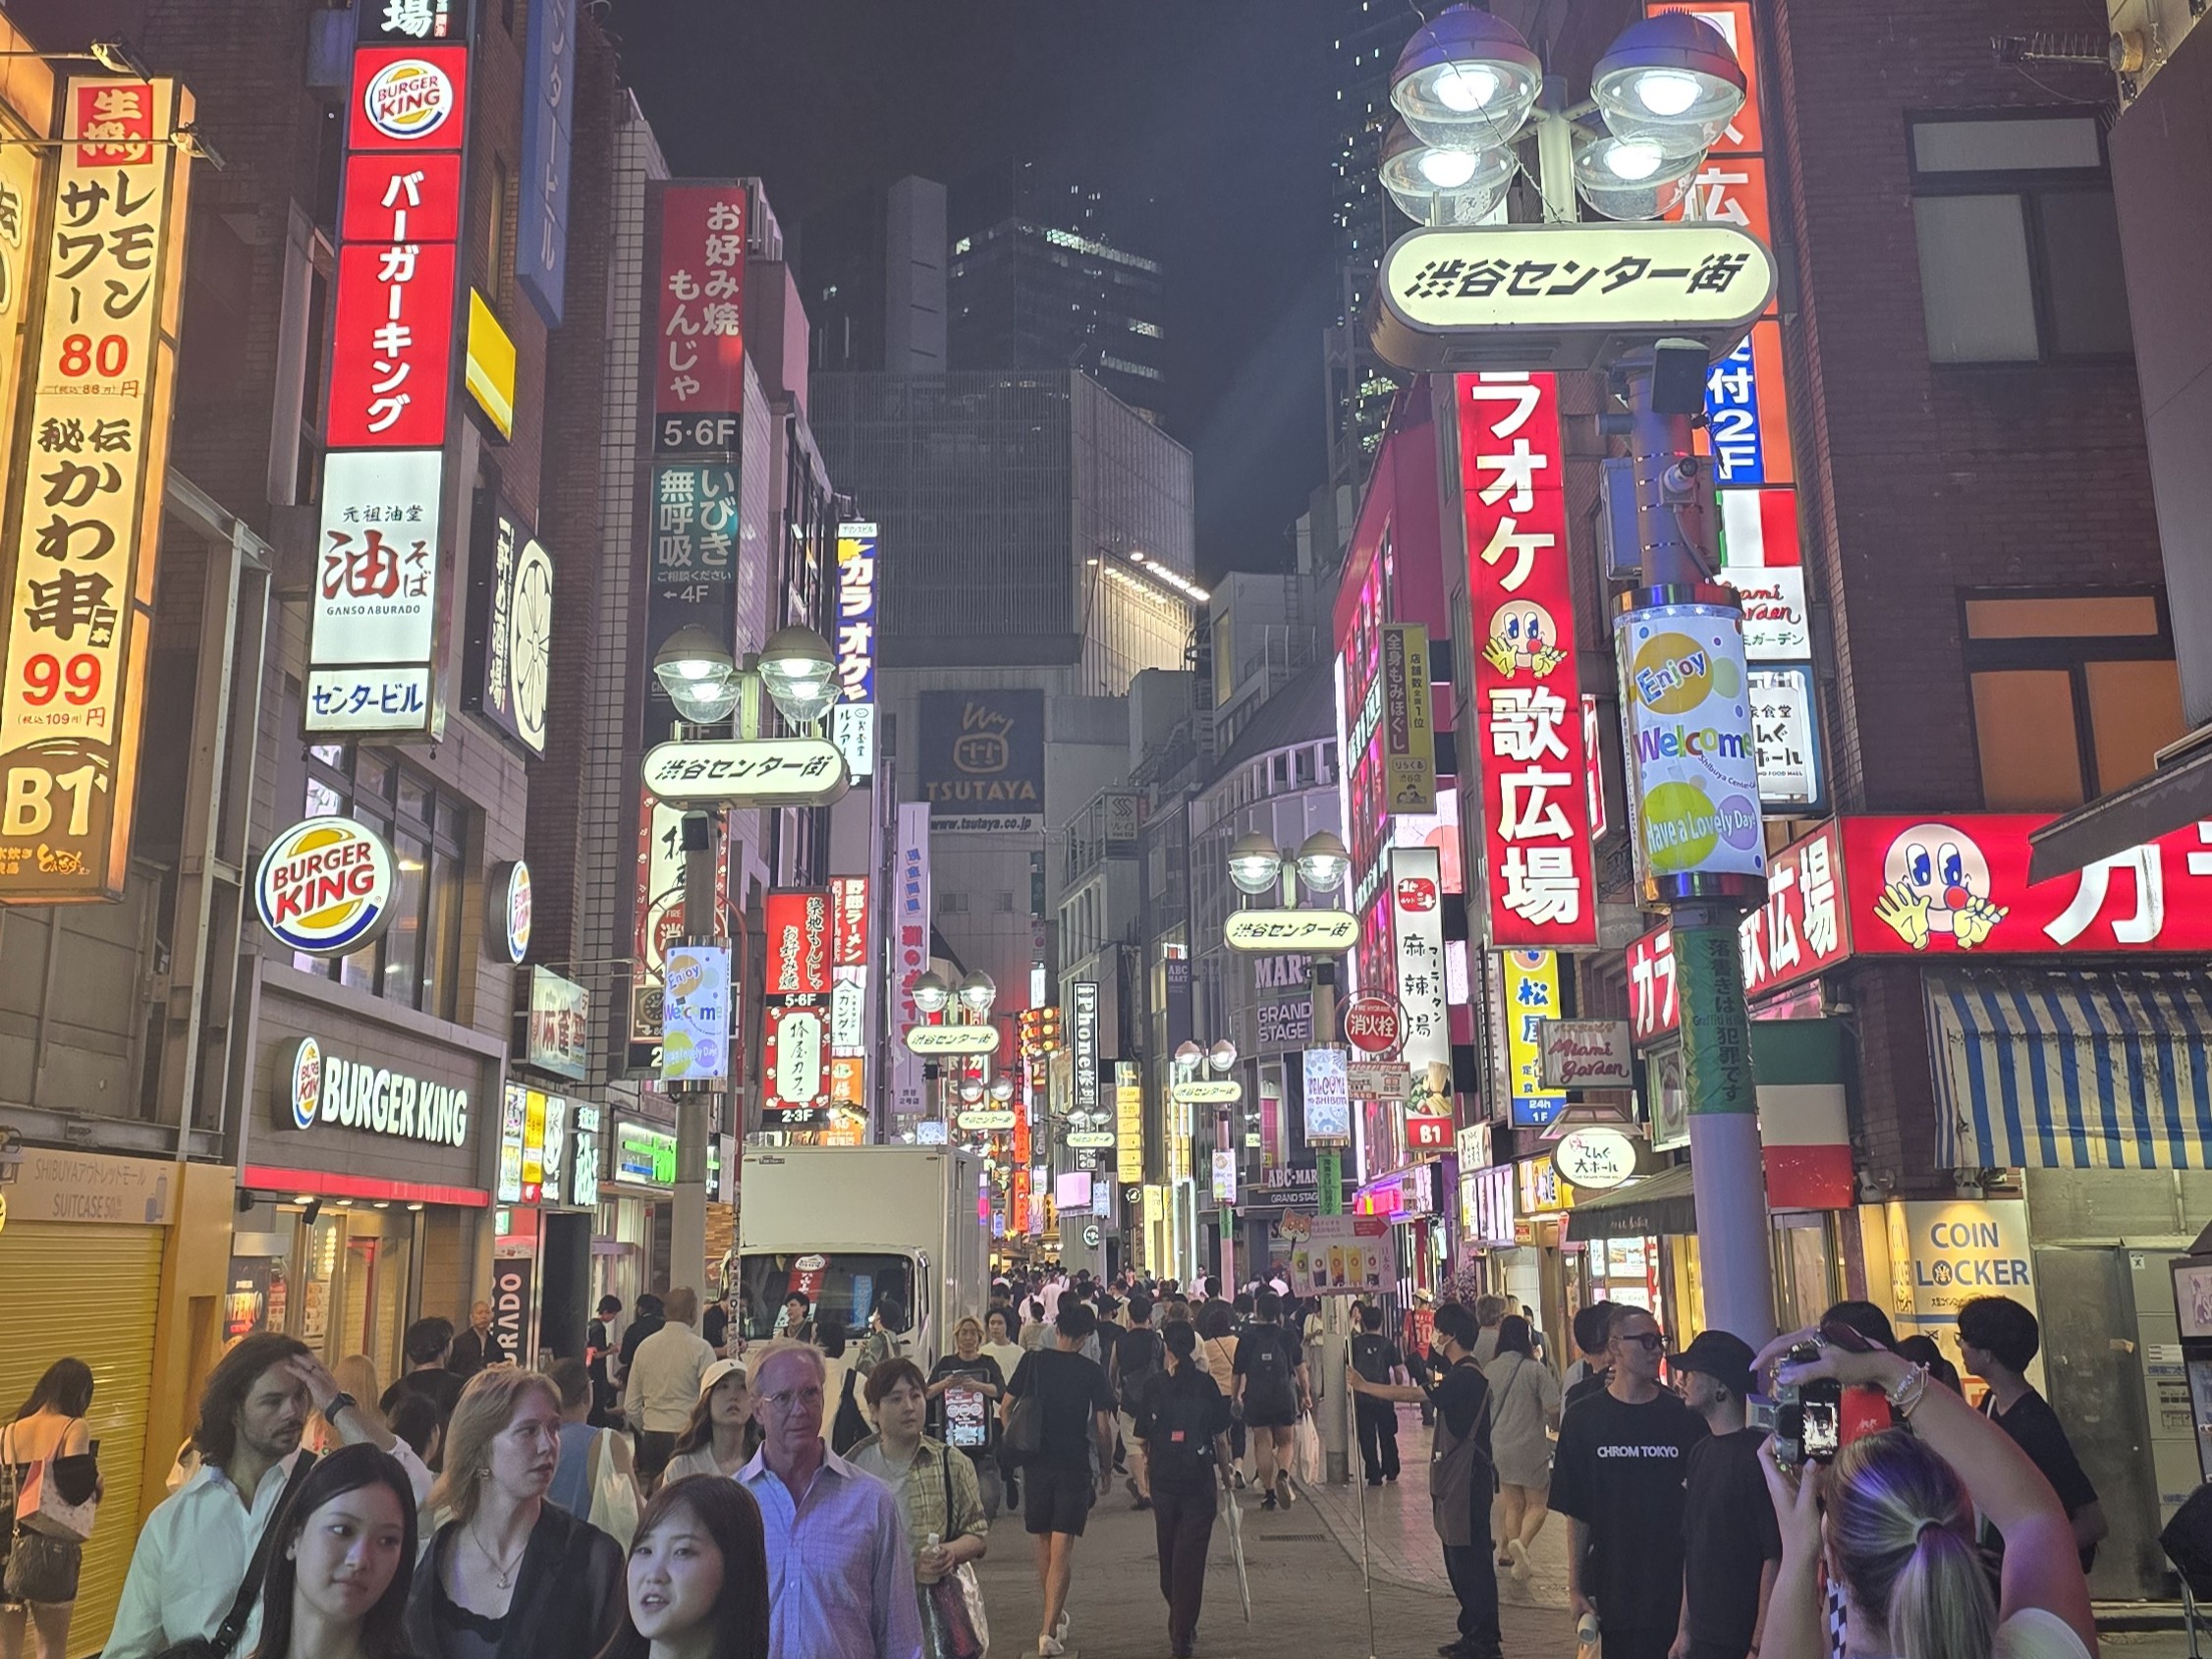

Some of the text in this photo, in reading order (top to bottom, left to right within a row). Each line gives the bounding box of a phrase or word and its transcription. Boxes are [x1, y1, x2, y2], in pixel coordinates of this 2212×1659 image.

[378, 76, 438, 103] BURGER
[379, 88, 440, 121] KING
[540, 0, 566, 271] ンタービル
[55, 180, 109, 323] サワー
[103, 170, 156, 319] レモン
[702, 201, 742, 337] お好み焼
[1405, 252, 1751, 299] 渋谷センター街
[367, 170, 424, 434] バーガーキング
[665, 269, 700, 402] もんじゃ
[59, 335, 128, 377] 80
[120, 380, 139, 399] 円
[37, 417, 133, 454] 秘伝
[1471, 372, 1555, 593] ラオケ
[342, 504, 424, 524] 元祖油堂
[658, 469, 695, 568] 無呼吸
[698, 469, 735, 567] いびき
[24, 459, 122, 641] かわ串
[657, 571, 732, 581] ご相談ください
[680, 585, 709, 603] 4F
[1741, 584, 1784, 601] ami
[327, 605, 420, 616] GANSO ABURADO
[1742, 603, 1801, 625] rden
[22, 653, 101, 706] 99
[1386, 633, 1405, 750] 全身もみほぐし
[1635, 650, 1707, 705] Enjoy
[312, 684, 423, 715] センタービル
[85, 706, 106, 728] 円
[1633, 725, 1752, 763] Welcome
[655, 754, 835, 781] 渋谷センター街
[1395, 760, 1423, 770] りらくる
[1698, 754, 1729, 783] Shibuya
[2, 766, 95, 836] B1
[926, 780, 1037, 802] TSUTAYA
[1488, 685, 1580, 926] 歌広場
[930, 816, 1032, 832] www.tsutaya.co.jp
[1645, 808, 1756, 856] Have a Lovely Day!
[272, 841, 372, 893] BURGER
[273, 863, 375, 927] KING
[845, 879, 864, 962] 野郎ラーメン
[1232, 921, 1352, 938] 渋谷センター街
[778, 924, 801, 990] お好み焼
[806, 897, 825, 990] 築地もんじゃ
[668, 964, 700, 990] Enjoy
[1168, 965, 1188, 975] ABC
[1168, 974, 1188, 983] MART
[1429, 946, 1442, 1023] マーラータン
[1403, 933, 1430, 1038] 麻辣湯
[1257, 1001, 1312, 1023] GRAND
[1351, 1015, 1395, 1038] 消火栓
[1693, 1015, 1724, 1027] Graffiti
[1707, 938, 1742, 1102] 落書きは犯罪です
[911, 1032, 993, 1046] 渋谷センター街
[1258, 1023, 1307, 1042] STAGE
[790, 1019, 809, 1095] 椿屋カフェ
[1548, 1038, 1614, 1057] Miami
[322, 1056, 416, 1138] BURGER
[416, 1077, 469, 1148] KING
[1532, 1111, 1548, 1122] 1F
[1419, 1125, 1441, 1142] B1
[1574, 1158, 1619, 1174] 大ホール
[1580, 1145, 1611, 1159] てんぐ
[53, 1192, 103, 1219] SUITCASE
[1271, 1191, 1318, 1203] GRAND STAG
[1930, 1221, 2000, 1248] COIN
[1915, 1258, 2031, 1287] LOCKER
[1597, 1445, 1679, 1458] CHROM TOKYO
